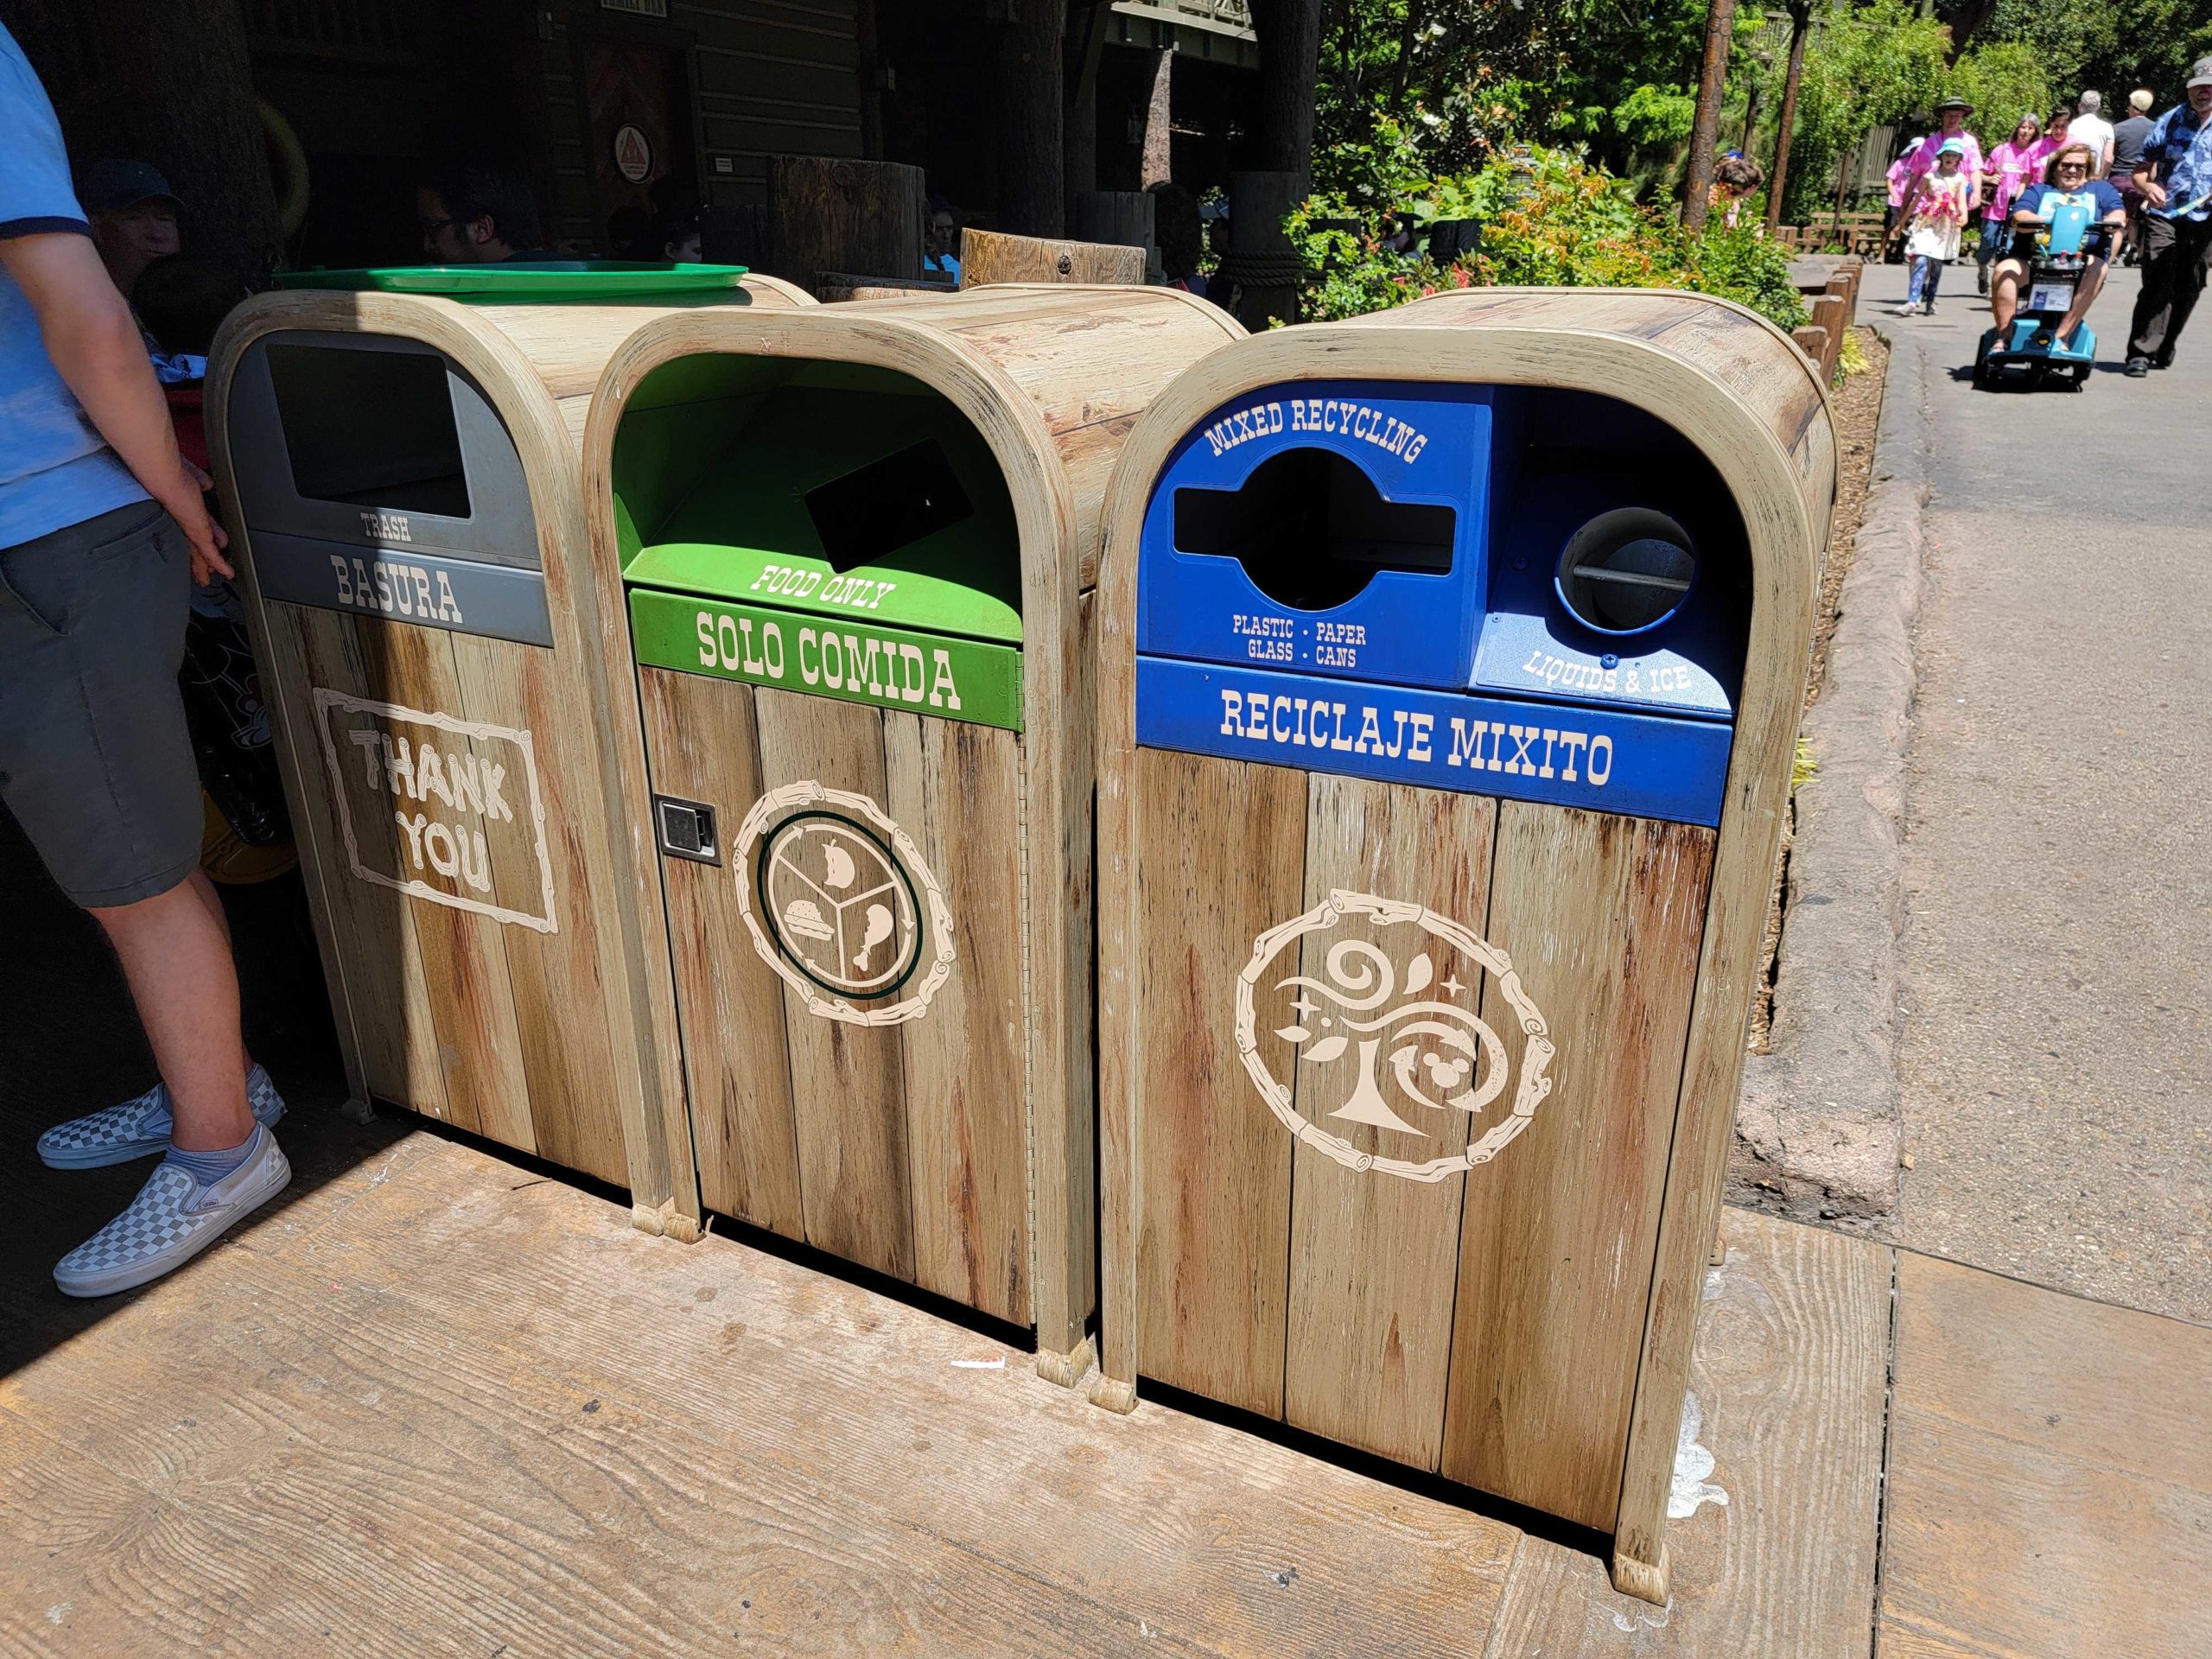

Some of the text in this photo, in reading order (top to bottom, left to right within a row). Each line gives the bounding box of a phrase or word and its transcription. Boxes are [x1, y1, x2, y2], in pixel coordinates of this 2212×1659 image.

[1205, 399, 1428, 464] MIXED RECYCLING
[360, 513, 412, 542] TRASH
[330, 554, 463, 624] BASURA
[750, 565, 897, 608] FOOD ONLY
[696, 611, 962, 710] SOLO COMIDA
[1232, 614, 1367, 646] PLASTIC PAPER
[1248, 639, 1357, 668] GLASS CANS
[1522, 651, 1692, 693] LIQUIDS & ICE
[1220, 690, 1613, 786] RECICLAJE MIXITO
[349, 730, 513, 823] THANK
[395, 810, 490, 893] YOU
